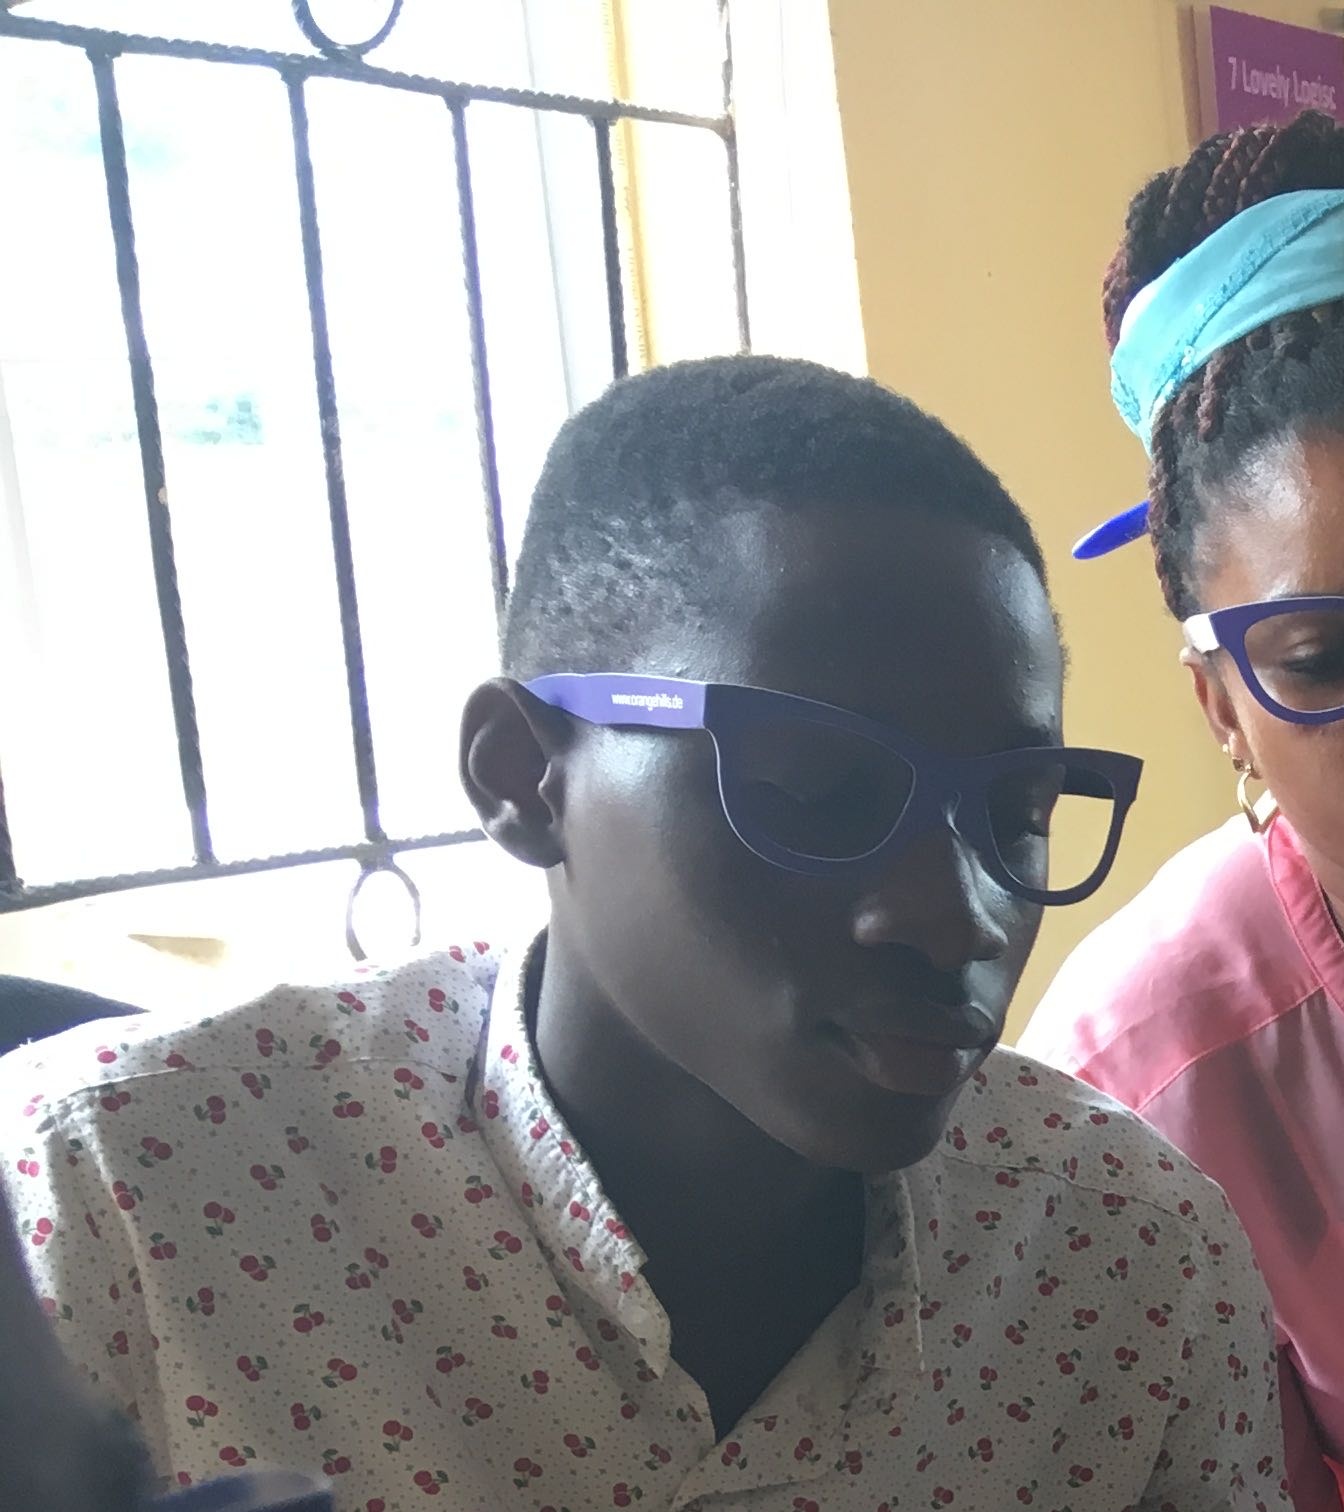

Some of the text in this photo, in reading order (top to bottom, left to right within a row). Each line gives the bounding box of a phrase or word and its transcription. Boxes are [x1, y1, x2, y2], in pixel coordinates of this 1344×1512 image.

[1228, 56, 1237, 90] 7
[1241, 60, 1290, 108] Lovely
[610, 693, 684, 712] www.orangehills.de
